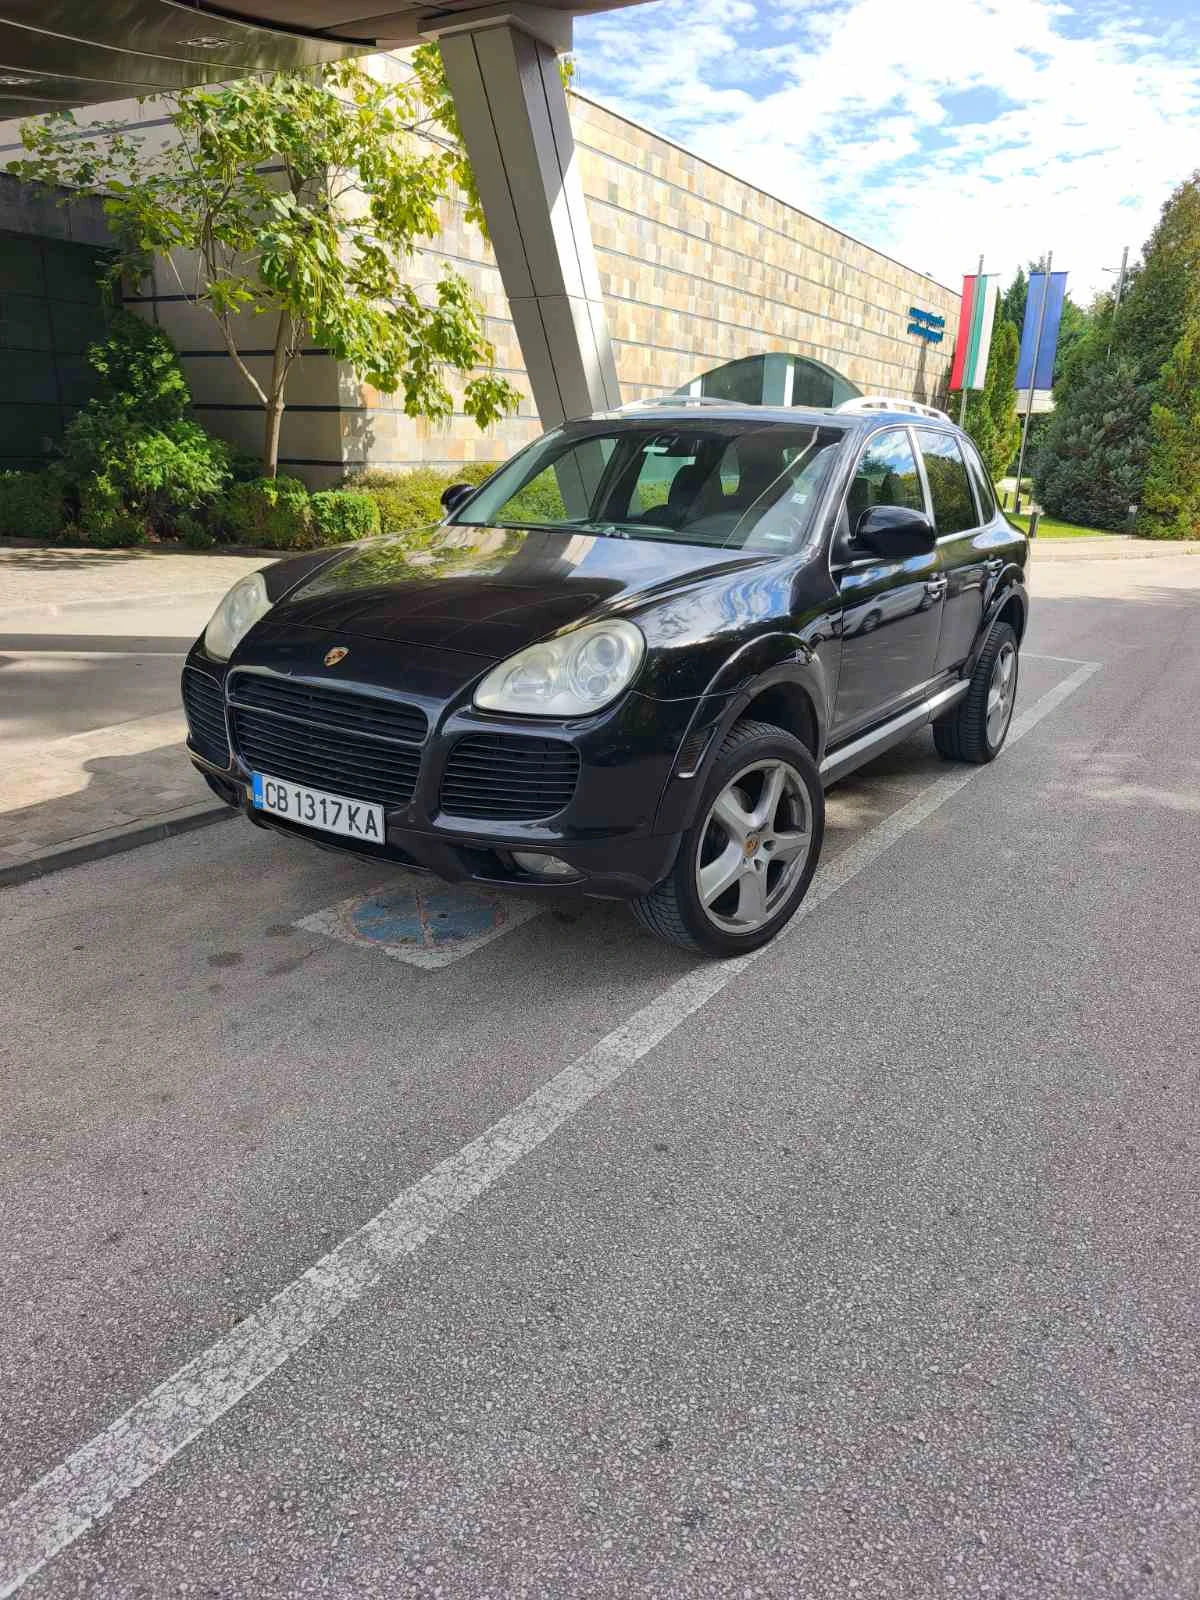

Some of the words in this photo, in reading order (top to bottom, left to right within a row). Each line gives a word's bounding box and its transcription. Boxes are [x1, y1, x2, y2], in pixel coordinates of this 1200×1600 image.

[266, 782, 288, 812] CB
[295, 791, 342, 826] 1317
[348, 805, 378, 837] KA
